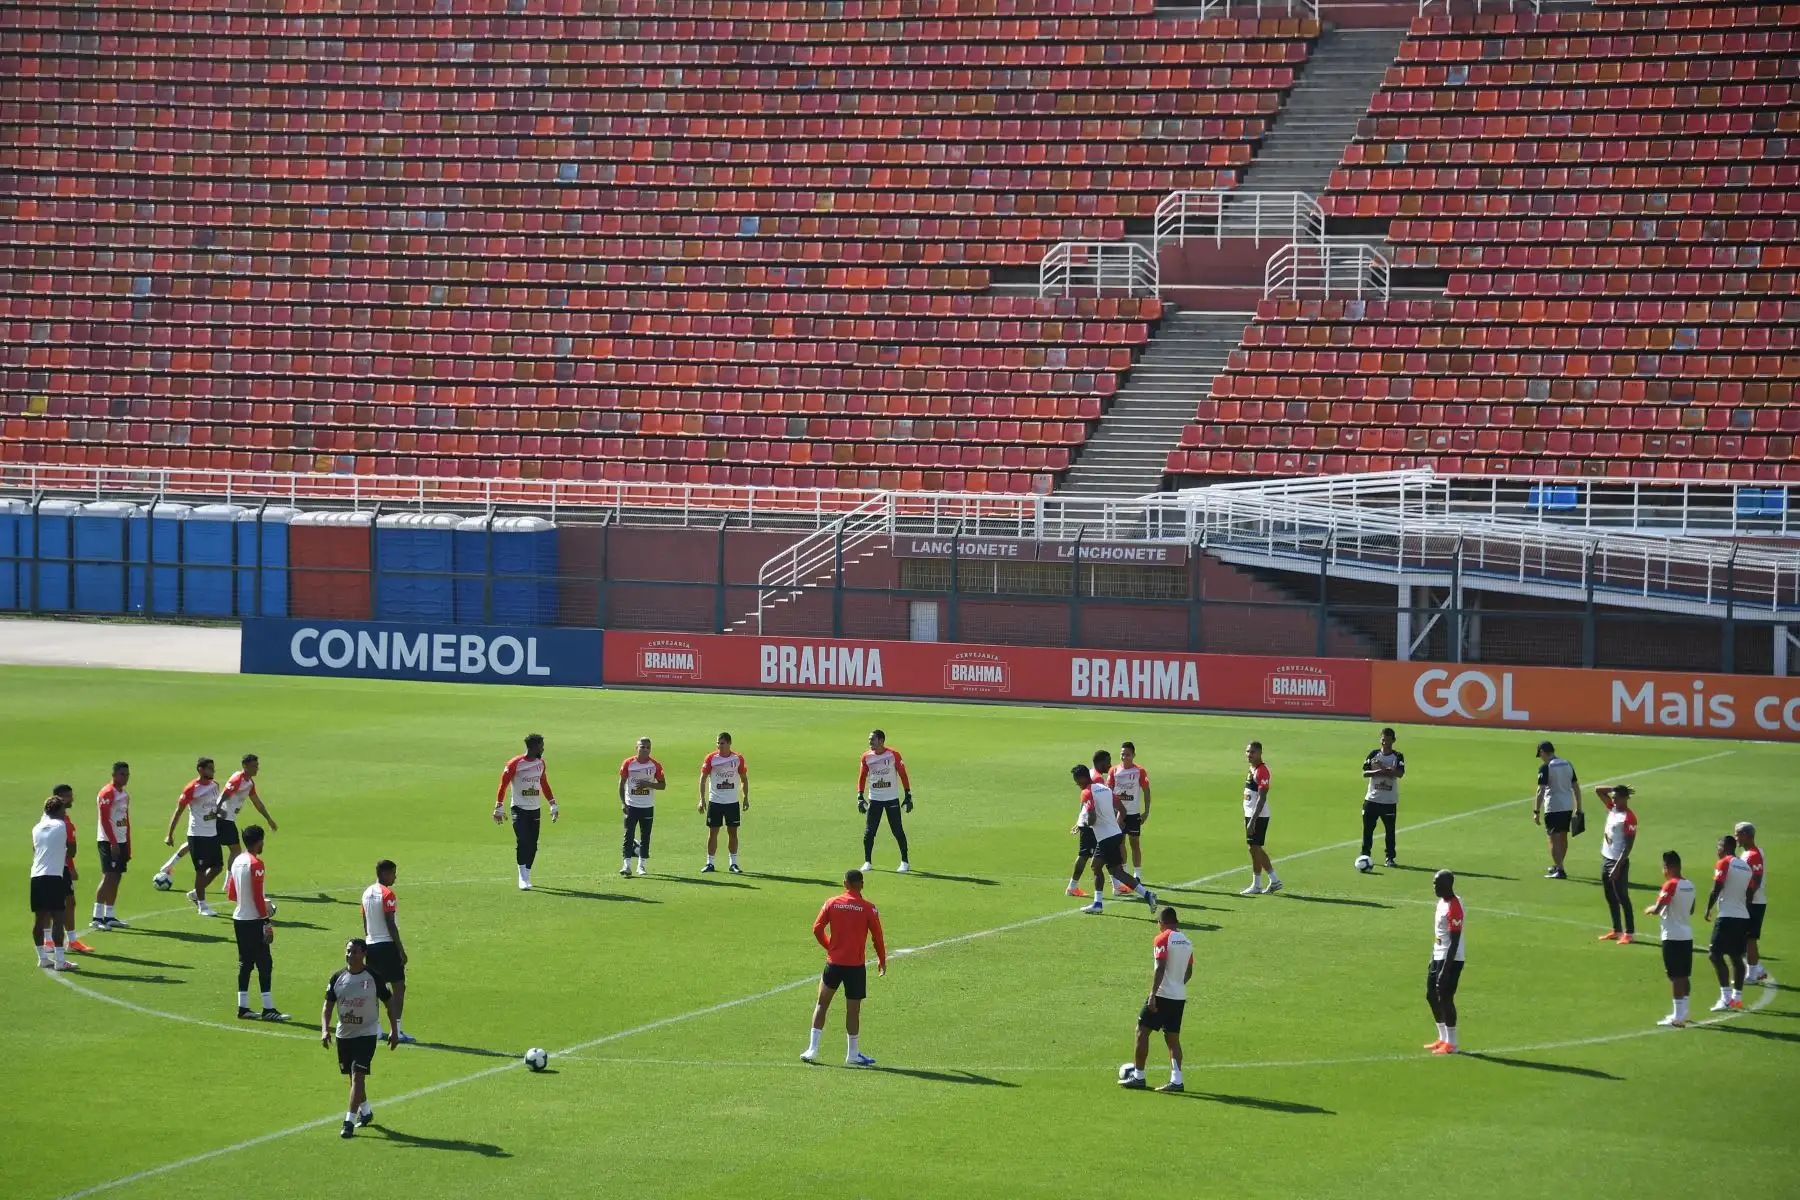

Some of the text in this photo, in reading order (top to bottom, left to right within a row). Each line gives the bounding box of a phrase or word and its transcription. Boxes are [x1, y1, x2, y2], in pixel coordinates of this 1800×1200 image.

[911, 541, 1018, 556] LANCHONETE
[1057, 546, 1167, 560] LANCHONETE
[290, 627, 550, 677] CONMEBOL
[644, 652, 694, 670] BRAHMA
[760, 644, 883, 688] BRAHMA
[951, 664, 1003, 683] BRAHMA
[1071, 657, 1200, 701] BRAHMA
[1272, 678, 1327, 697] BRAHMA
[1413, 668, 1530, 721] GOL
[1611, 679, 1736, 728] Mais
